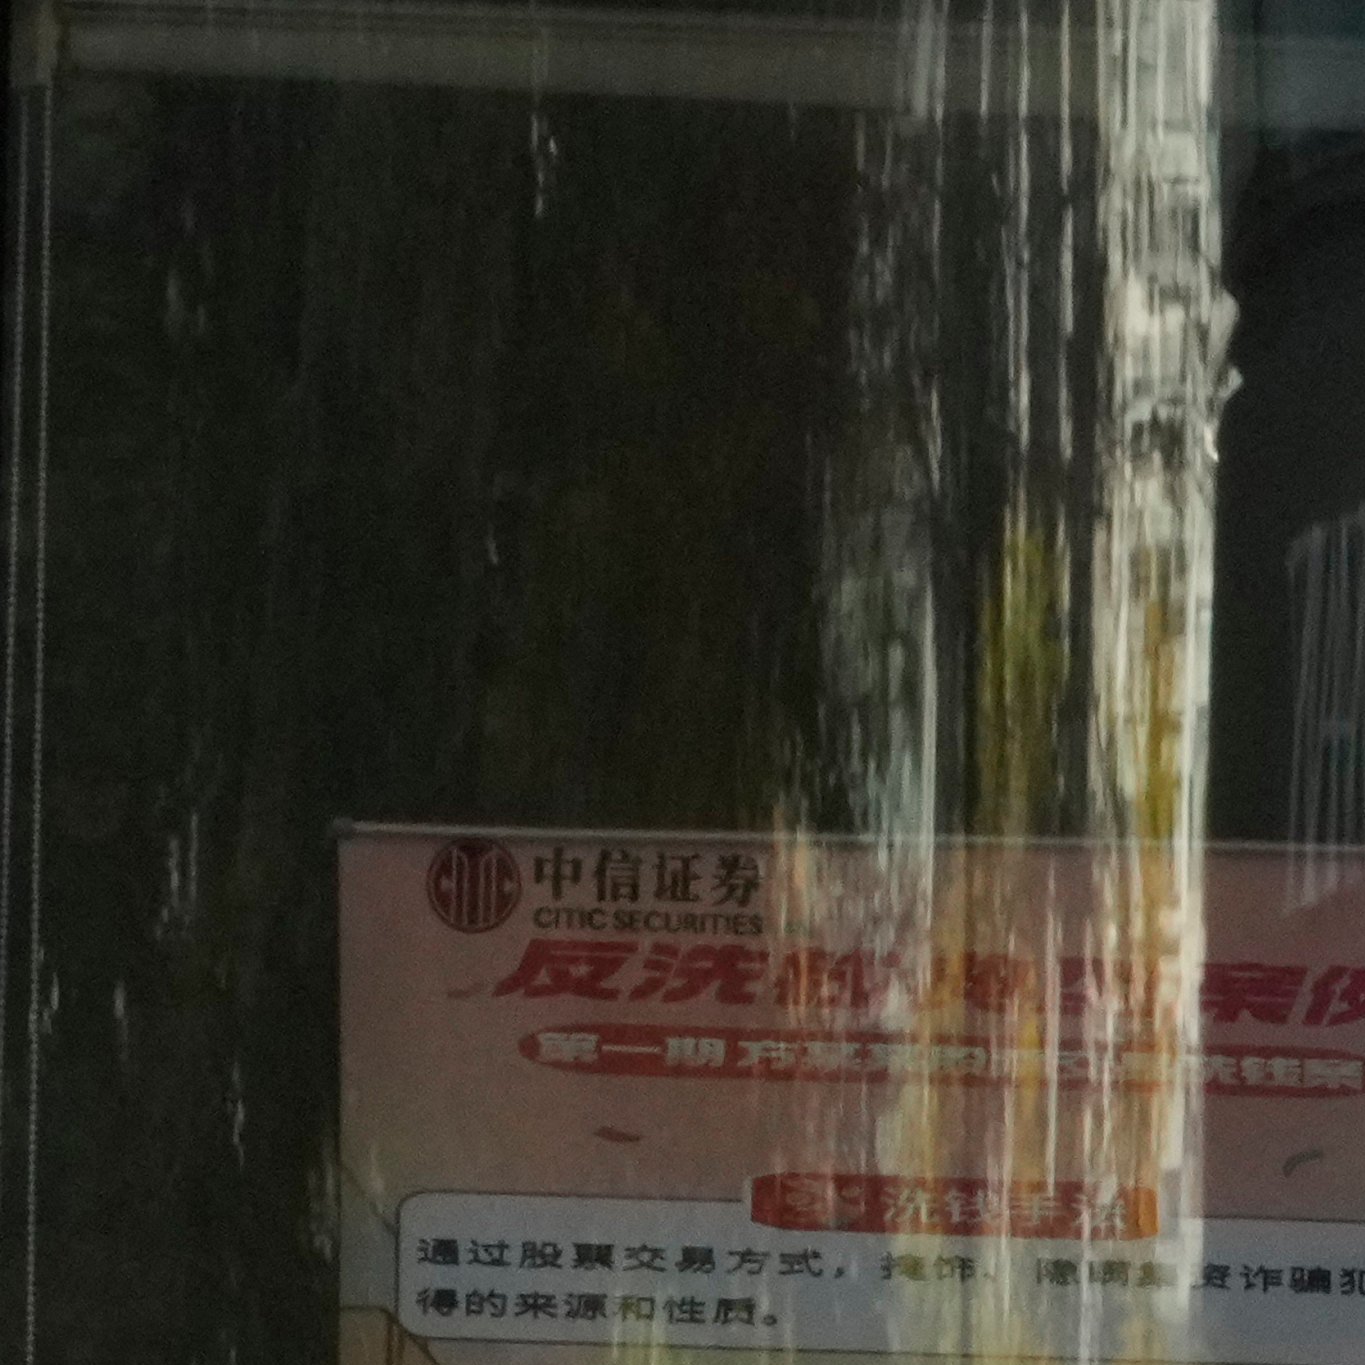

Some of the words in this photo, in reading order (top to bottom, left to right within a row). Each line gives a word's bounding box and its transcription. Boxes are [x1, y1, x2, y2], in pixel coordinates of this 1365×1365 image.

[532, 846, 763, 906] 中信证券
[533, 907, 607, 930] CITIC
[612, 908, 764, 936] SECURITIES
